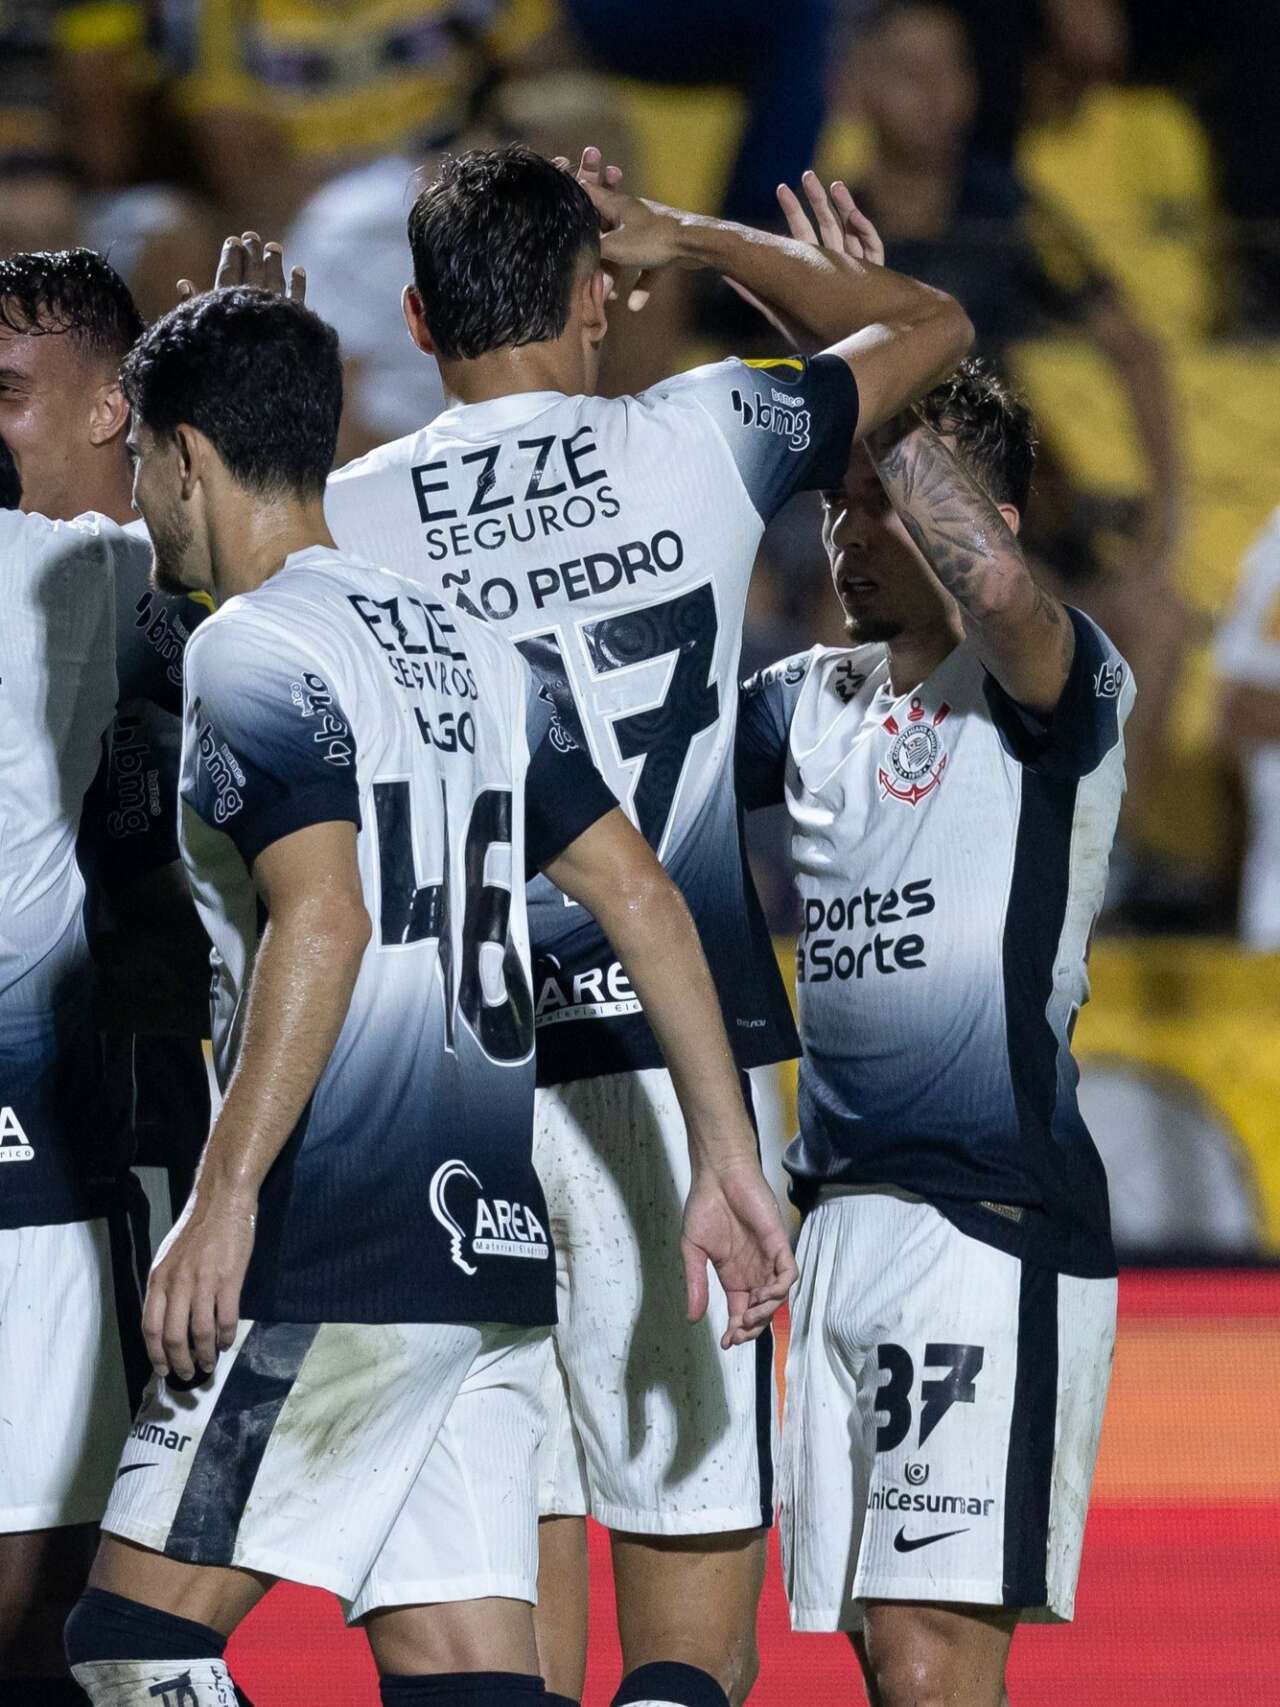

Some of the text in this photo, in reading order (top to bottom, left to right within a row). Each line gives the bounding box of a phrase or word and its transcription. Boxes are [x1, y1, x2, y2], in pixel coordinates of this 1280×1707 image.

[754, 391, 811, 452] bmg
[411, 426, 608, 523] EZZE
[426, 485, 620, 561] SEGUROS
[441, 529, 684, 623] ÃO PEDRO
[346, 594, 467, 661] EZZE
[389, 656, 478, 700] SEGUROS
[198, 722, 243, 823] bmg
[370, 772, 536, 1068] 46
[800, 878, 936, 943] portes
[535, 961, 638, 1017] ARE
[809, 932, 927, 983] Sorte
[475, 1198, 547, 1243] AREA
[876, 1342, 985, 1453] 37
